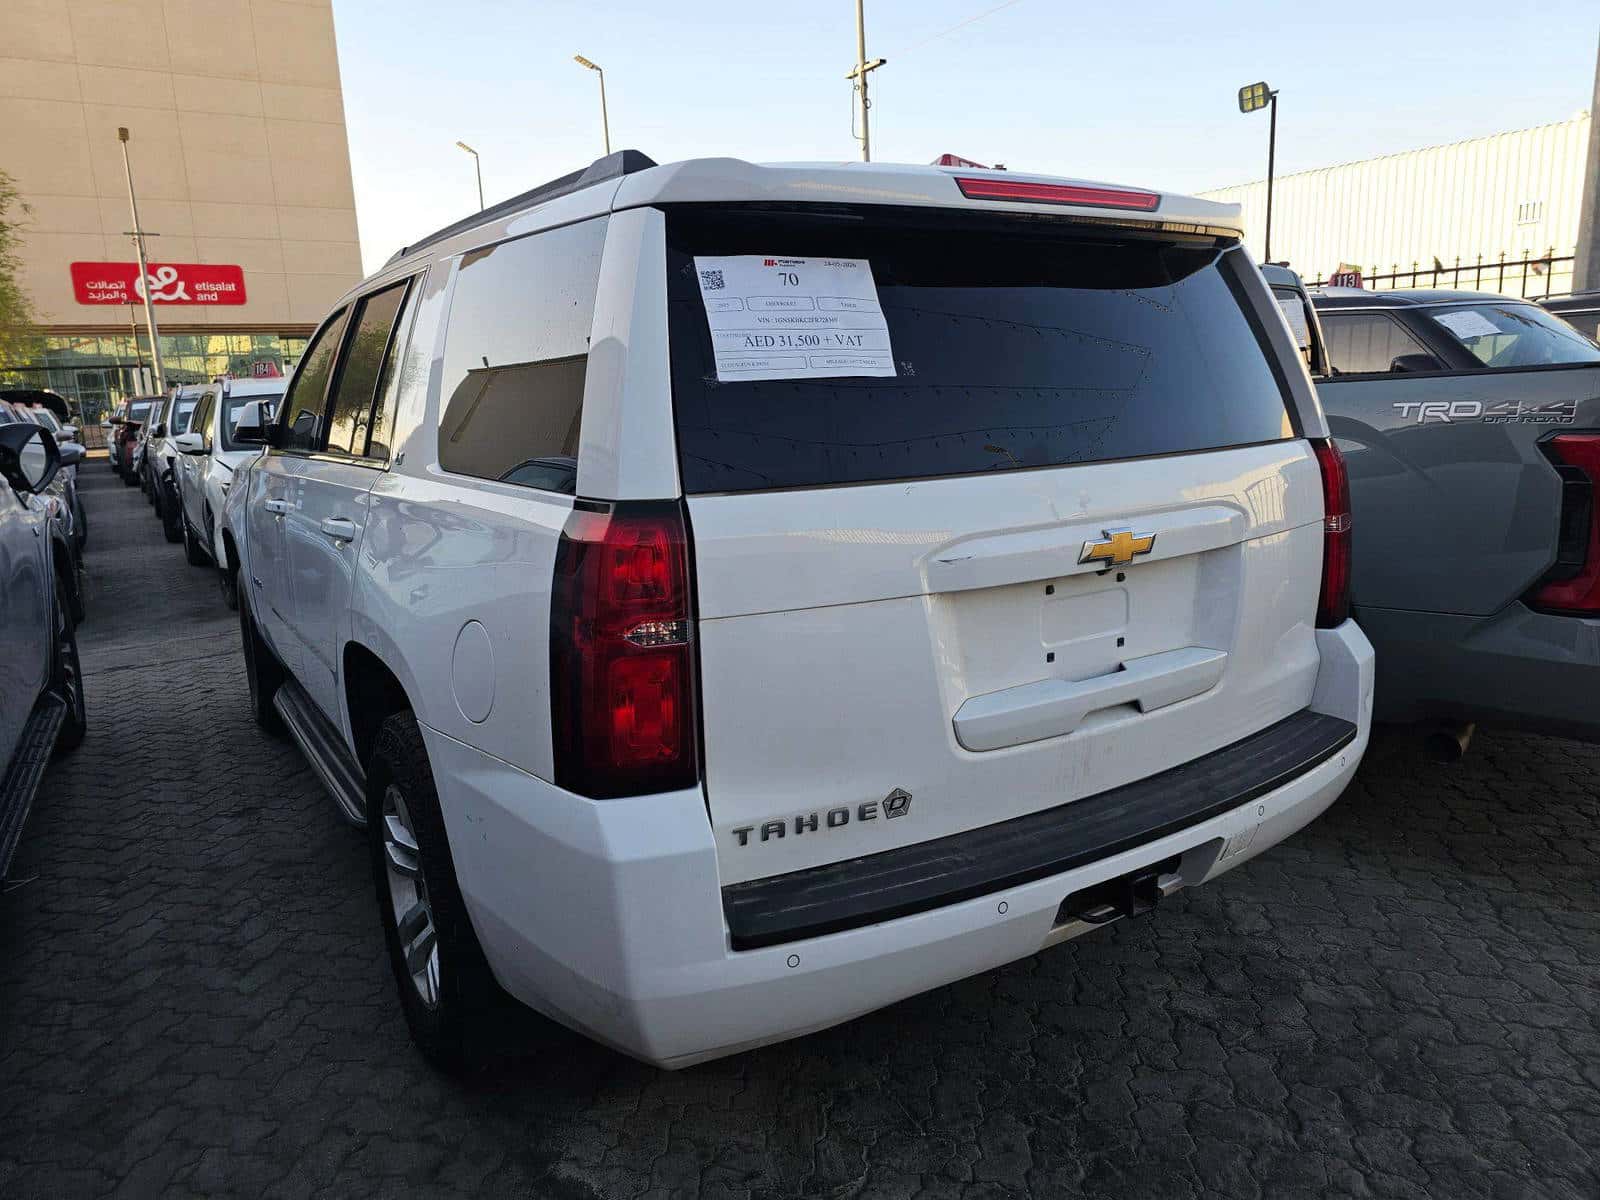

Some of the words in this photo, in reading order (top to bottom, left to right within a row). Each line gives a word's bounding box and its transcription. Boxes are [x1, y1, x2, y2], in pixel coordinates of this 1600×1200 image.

[86, 280, 126, 290] اتصالات
[778, 272, 799, 287] 70
[1336, 274, 1356, 288] 113
[195, 282, 236, 292] etisalat
[197, 292, 217, 302] and
[744, 335, 775, 348] AED
[823, 335, 834, 345] +
[834, 334, 864, 347] VAT
[1393, 401, 1482, 424] TRD
[732, 801, 878, 847] TAHOE
